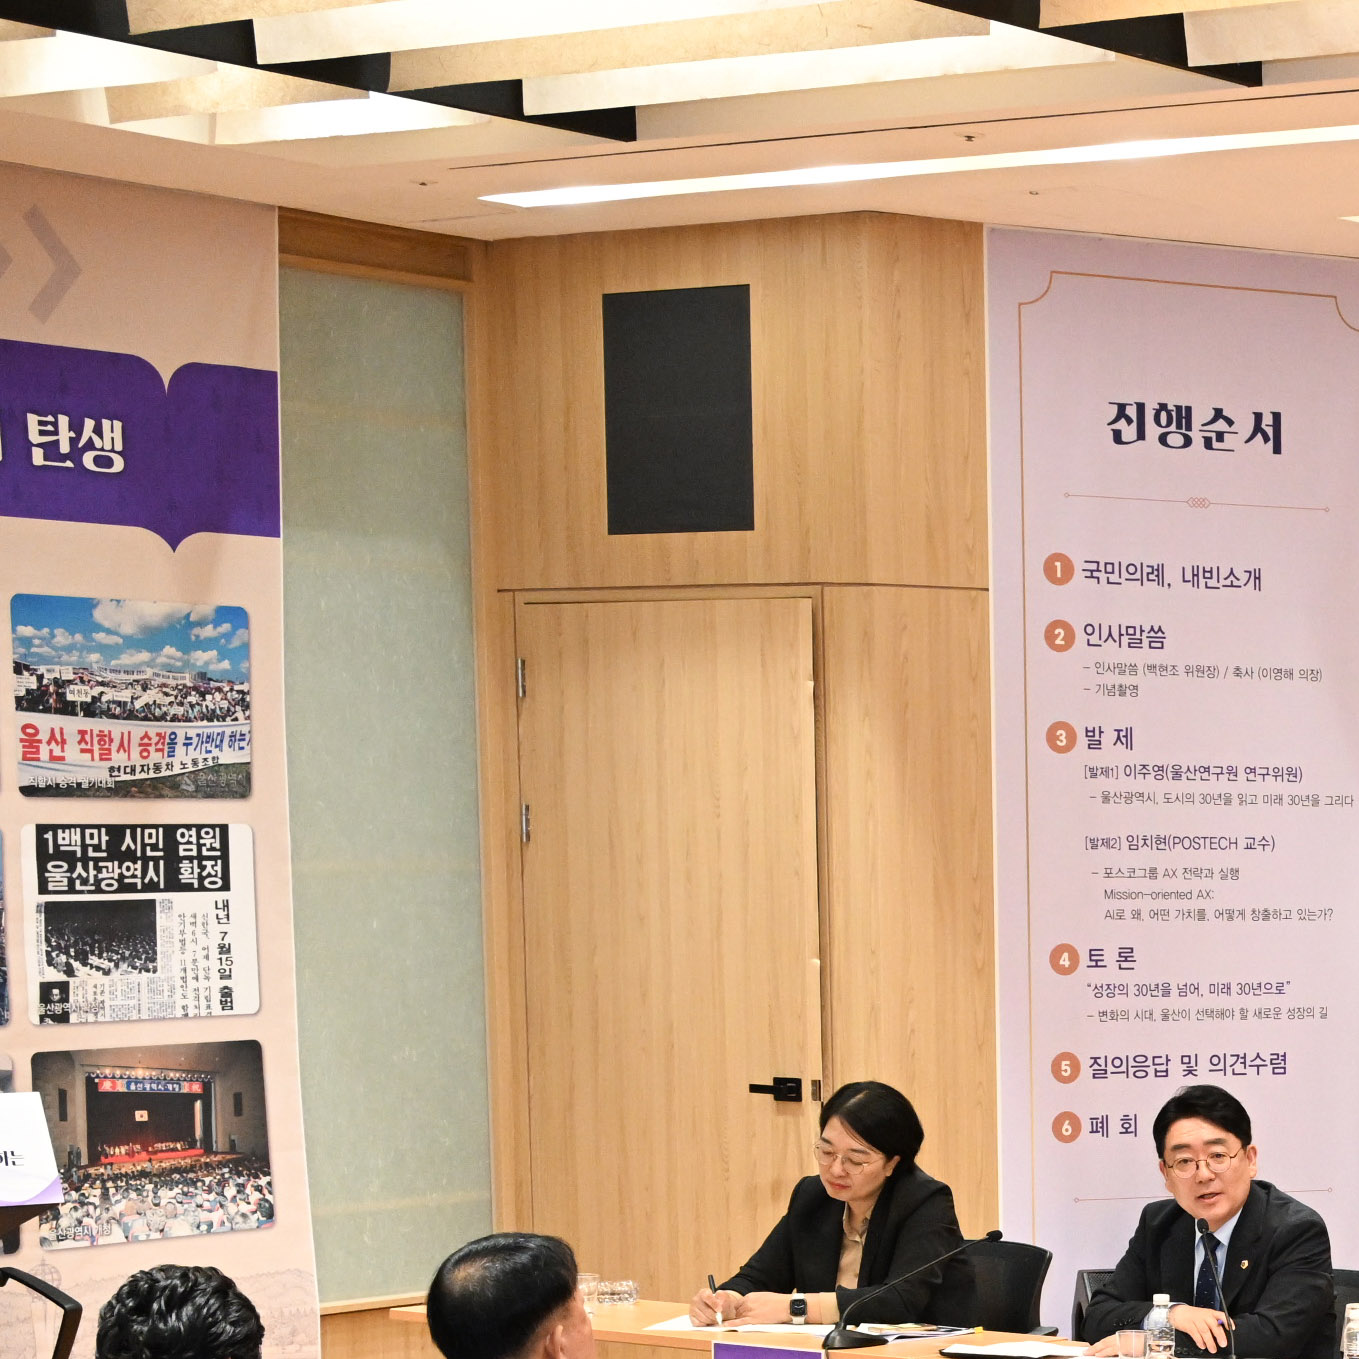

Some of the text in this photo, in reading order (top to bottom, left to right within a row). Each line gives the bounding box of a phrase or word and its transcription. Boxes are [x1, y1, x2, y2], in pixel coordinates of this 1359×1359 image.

[1106, 401, 1282, 455] 진행순서
[26, 412, 125, 474] 탄생
[1054, 560, 1262, 592] 1 국민의례, 내빈소개
[1054, 623, 1167, 650] 2 인사말씀
[1094, 661, 1139, 676] 인사말씀
[1142, 662, 1180, 678] (백현조
[1184, 664, 1220, 680] 위원장)
[1232, 665, 1254, 680] 축사
[1257, 666, 1294, 682] (이영해
[1298, 667, 1323, 683] 의장)
[1095, 683, 1139, 698] 기념촬영
[19, 722, 67, 762] 울산
[77, 728, 131, 761] 직할시
[138, 730, 178, 760] 승격을
[182, 730, 226, 756] 누가반대
[1055, 729, 1067, 746] 3
[107, 755, 220, 778] 현대자동차 노동조합
[1084, 763, 1303, 784] [발제1] 이주영(울산연구원 연구위원)
[28, 776, 56, 789] 직할시
[59, 777, 77, 789] 승격
[1100, 790, 1354, 808] 울산광역시, 도시의 30년을 읽고 미래 30년을 그리다
[43, 827, 222, 858] 1백만 시민 염원
[1084, 834, 1276, 852] [발제2] 임치현(POSTECH 교수)
[44, 859, 223, 892] 울산광역시 확정
[1102, 866, 1240, 881] 포스코그룹 AX 전략과 실행
[1104, 889, 1215, 900] Mission-oriented AX:
[215, 899, 231, 925] 내년
[1104, 908, 1127, 921] AI로
[1148, 908, 1171, 922] 어떤
[1174, 908, 1210, 922] 가치를,
[1214, 907, 1246, 922] 어떻게
[1250, 907, 1293, 922] 창출하고
[1296, 907, 1334, 922] 있는가?
[1059, 952, 1070, 968] 4
[1133, 982, 1173, 999] 30년을
[1176, 982, 1204, 998] 넘어,
[1208, 981, 1232, 997] 미래
[1098, 1005, 1328, 1023] 변화의 시대, 울산이 선택해야 할 새로운 성장의 길
[1060, 1051, 1288, 1080] 5 질의응답 및 의견수렴
[1061, 1120, 1072, 1136] 6
